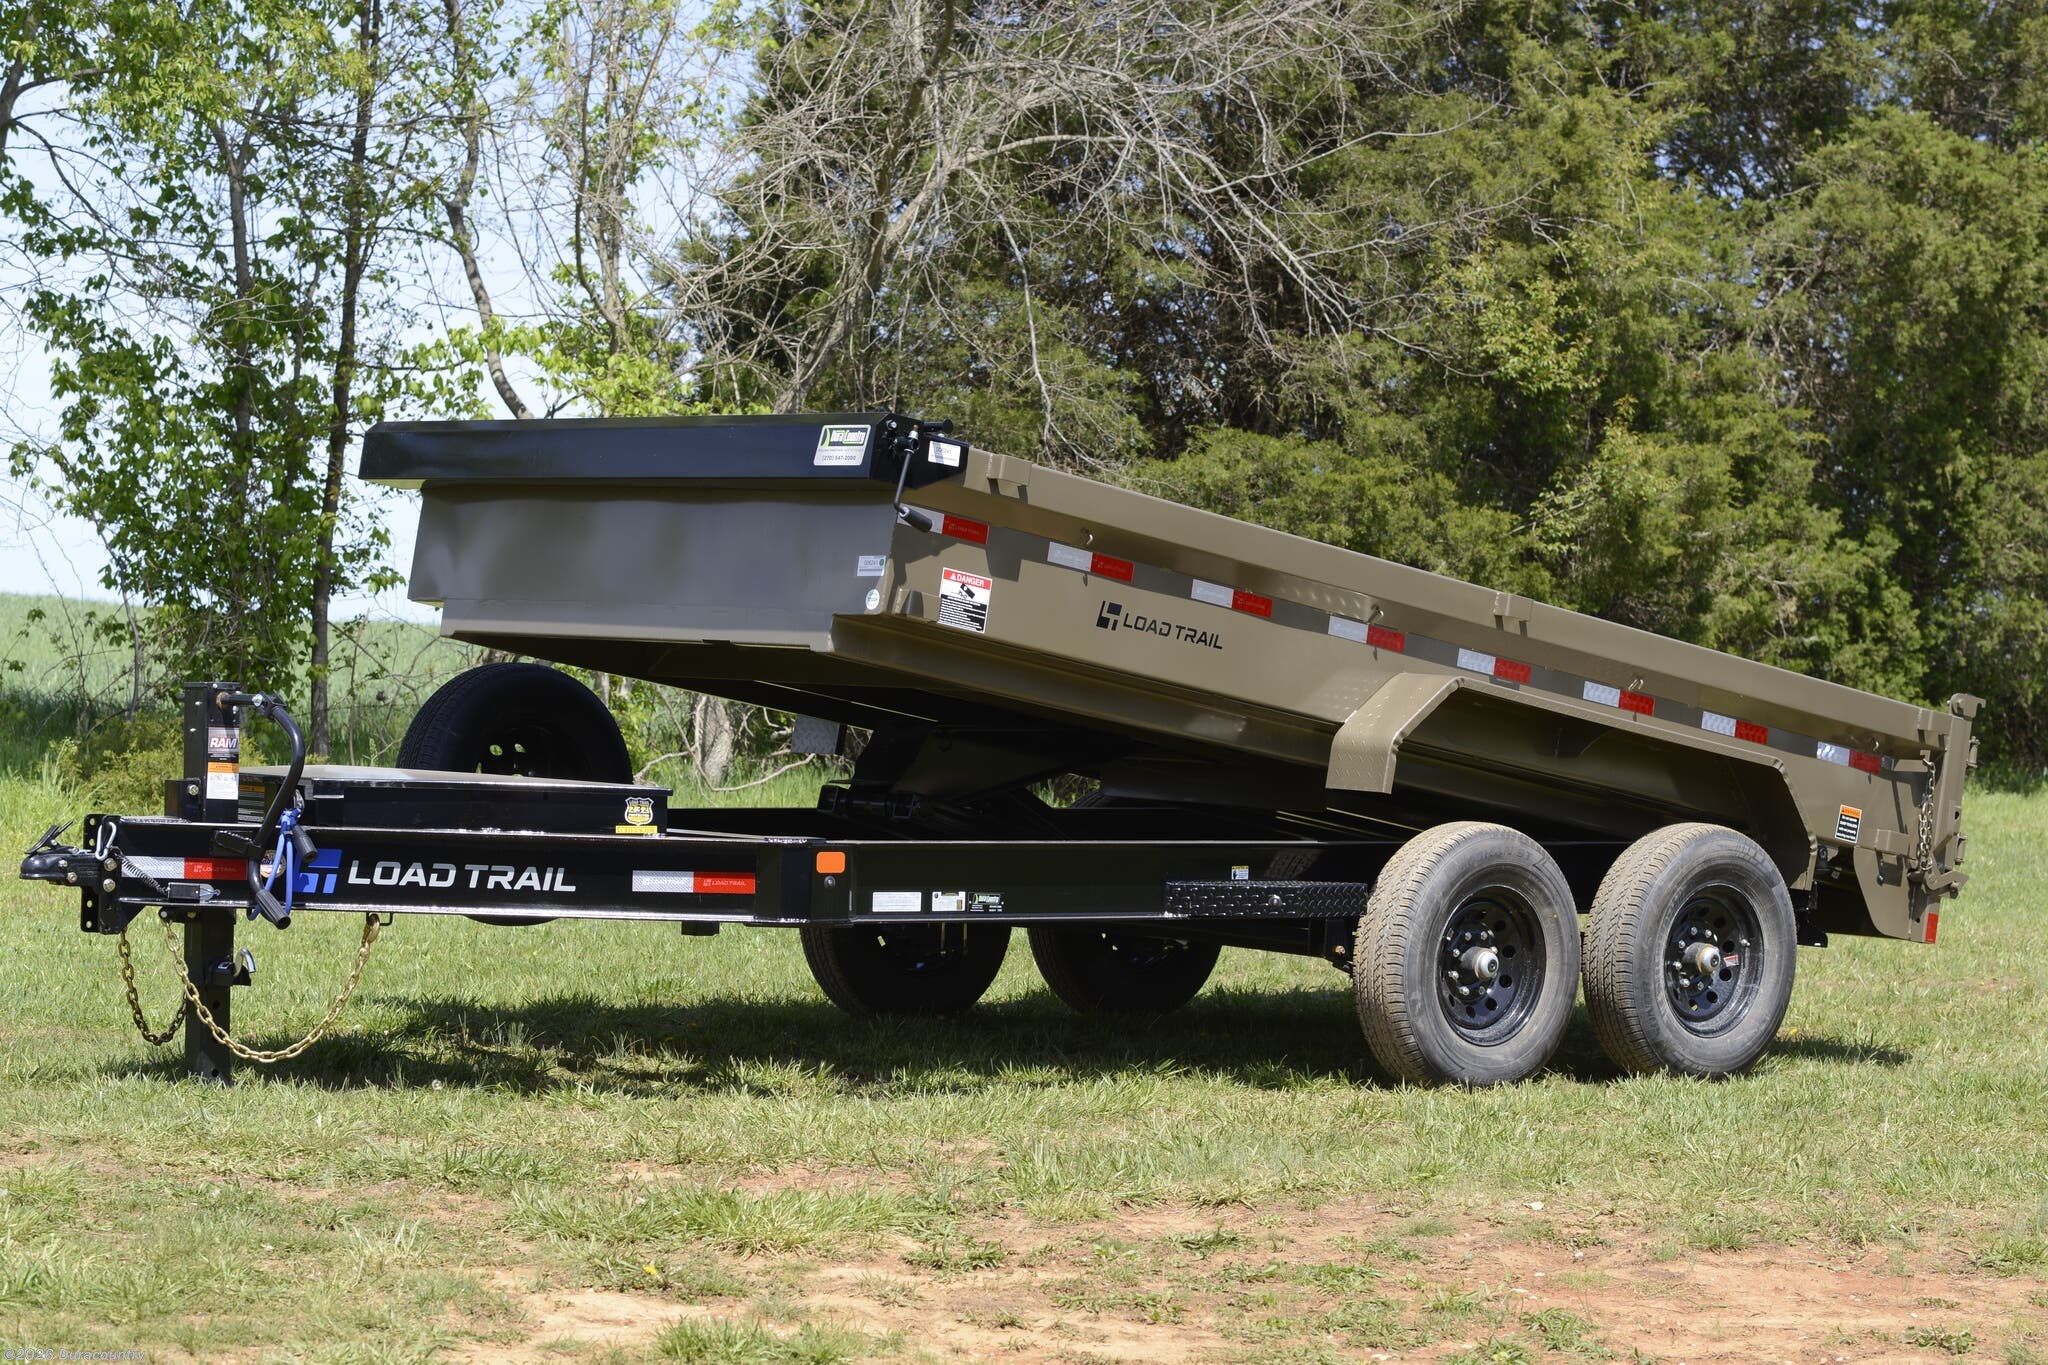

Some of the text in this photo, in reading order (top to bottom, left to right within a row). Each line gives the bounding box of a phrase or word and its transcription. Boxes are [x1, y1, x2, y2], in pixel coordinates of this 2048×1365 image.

[956, 573, 985, 587] DANGER
[1122, 612, 1223, 650] LOAD TRAIL
[209, 737, 237, 749] RAM
[348, 859, 577, 893] LOAD TRAIL
